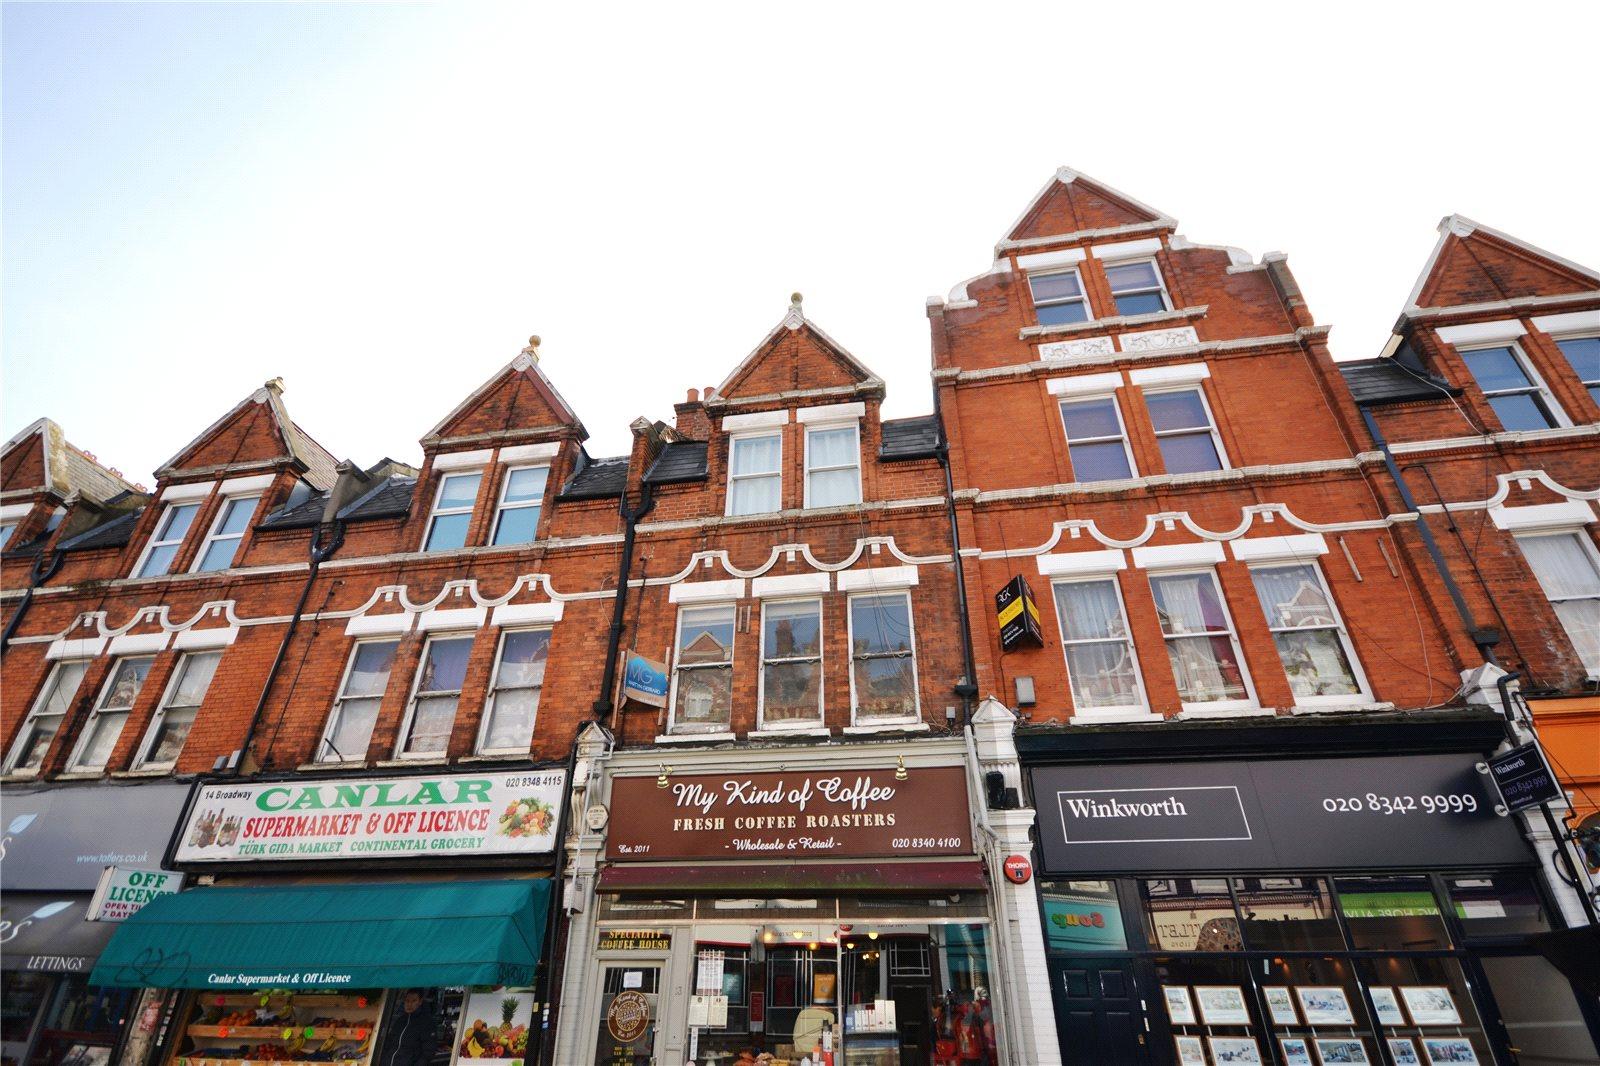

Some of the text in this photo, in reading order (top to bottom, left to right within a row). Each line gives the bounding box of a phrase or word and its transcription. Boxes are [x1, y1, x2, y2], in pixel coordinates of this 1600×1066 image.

[629, 663, 653, 684] MG
[1494, 759, 1526, 775] Winkworth
[505, 776, 562, 787] 020 8348 4115
[205, 789, 252, 801] 14 Broadway
[255, 779, 493, 812] CANLAR
[672, 776, 896, 814] My Kind of Coffee
[1066, 796, 1188, 819] Winkworth
[1323, 793, 1477, 815] 020 8342 9999
[242, 809, 490, 838] SUPERMARKET & OFF LICENCE
[673, 813, 896, 831] FRESH COFFEE ROASTERS
[238, 837, 485, 855] TÜRK GIDA MARKET CONTINENTAL GROCERY
[634, 845, 650, 853] 2011
[732, 837, 834, 851] Wholesale & Retail
[892, 837, 961, 848] 020 8340 4100
[128, 872, 168, 888] OFF
[109, 886, 175, 902] LICEN
[104, 902, 128, 910] OPEN
[601, 940, 669, 950] COFFEE HOUSE
[26, 955, 86, 970] LETTINGS
[208, 973, 351, 986] Canlar Supermarket & Off Licence
